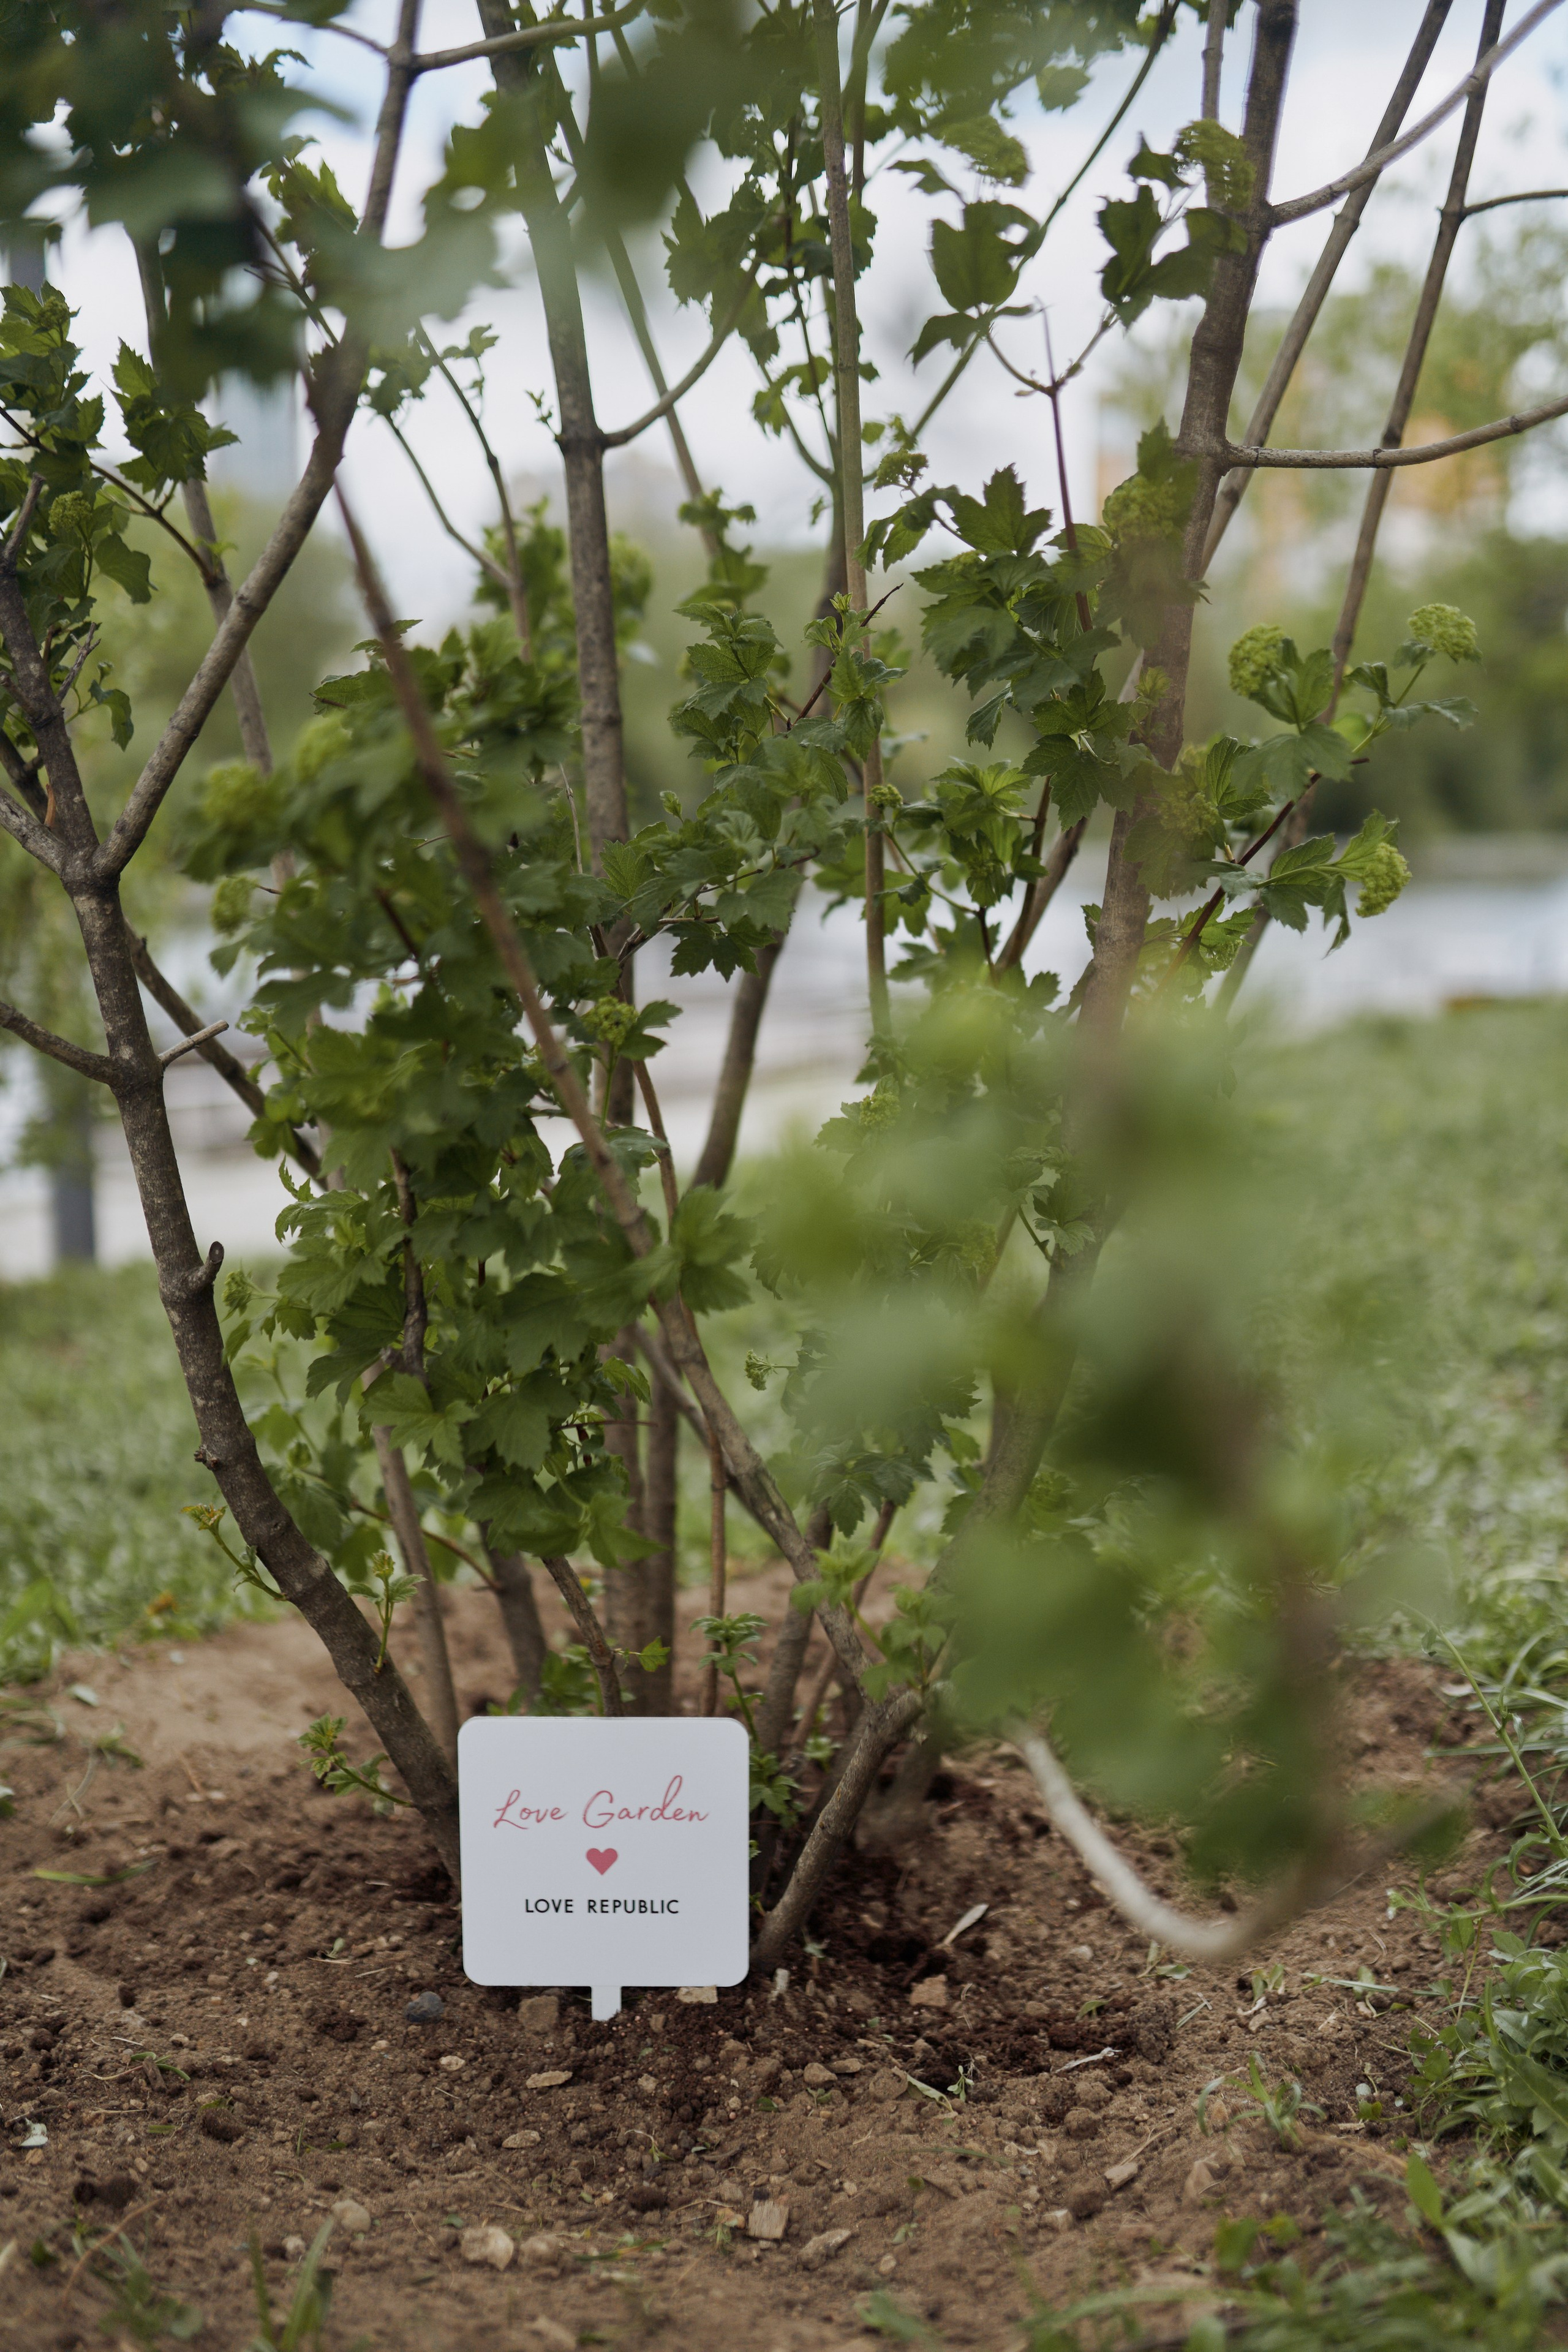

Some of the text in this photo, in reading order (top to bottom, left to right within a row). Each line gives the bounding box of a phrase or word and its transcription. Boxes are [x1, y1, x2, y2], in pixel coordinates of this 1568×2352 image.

[493, 1774, 709, 1830] Love Garden
[525, 1898, 680, 1915] LOVE REPUBLIC
